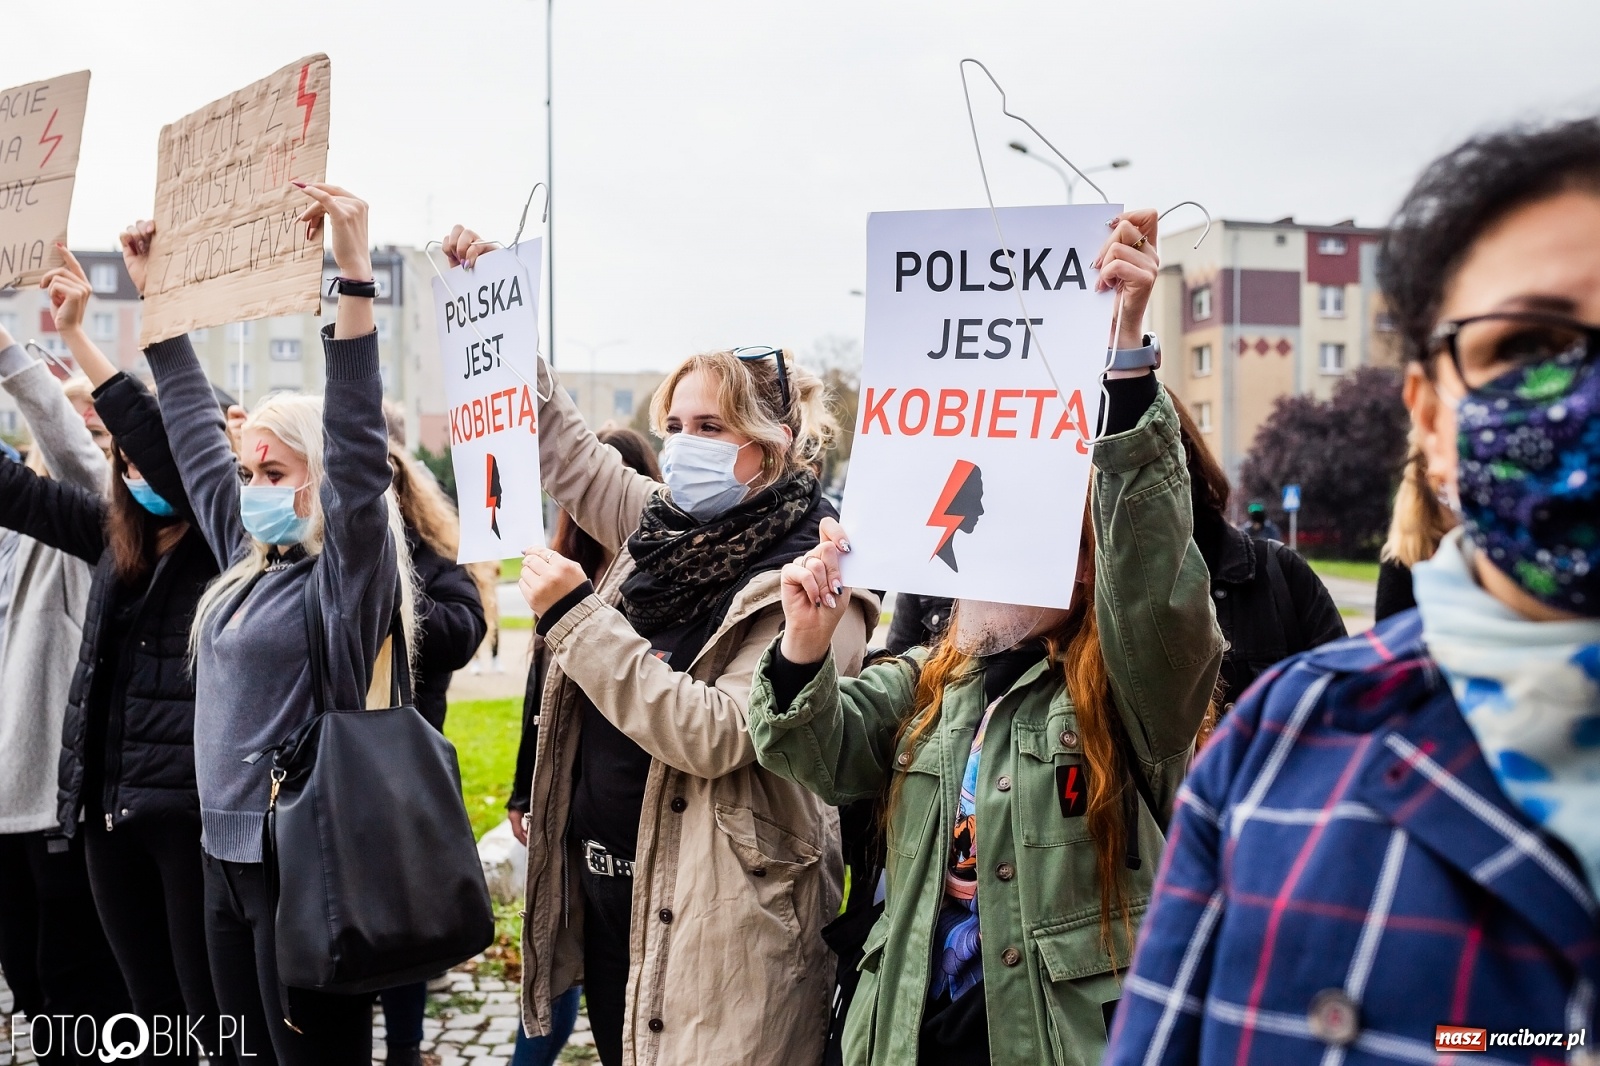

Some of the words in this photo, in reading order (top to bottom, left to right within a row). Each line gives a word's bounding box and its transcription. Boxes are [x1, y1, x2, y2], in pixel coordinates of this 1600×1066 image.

[265, 88, 283, 133] Z
[263, 137, 306, 193] NIE
[160, 252, 174, 294] Z
[183, 203, 308, 287] KOBIETAMI
[895, 247, 1087, 292] POLSKA
[445, 275, 523, 334] POLSKA
[463, 333, 504, 379] JEST
[926, 317, 1044, 360] JEST
[450, 384, 537, 445] KOBIETĄ
[861, 387, 1091, 454] KOBIETĄ
